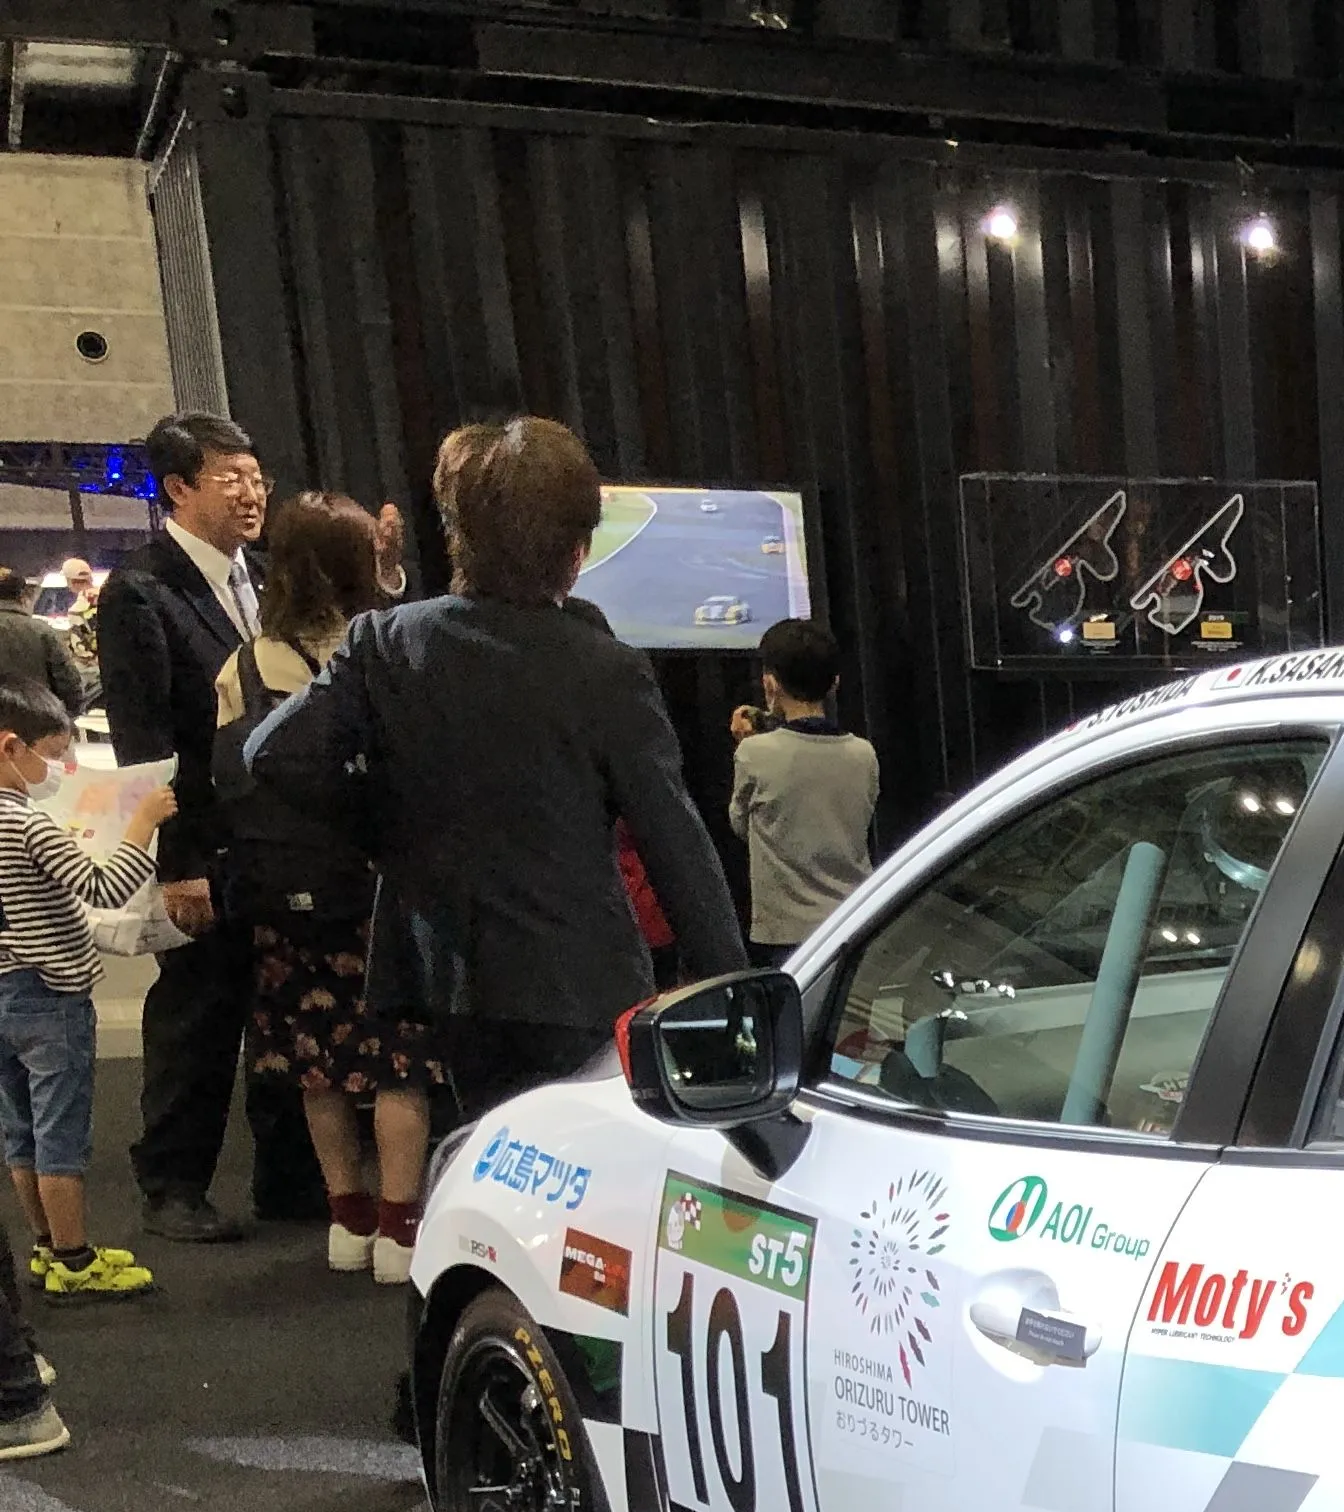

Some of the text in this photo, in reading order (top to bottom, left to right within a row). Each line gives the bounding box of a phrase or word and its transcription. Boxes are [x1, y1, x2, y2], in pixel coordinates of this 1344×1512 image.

[495, 1138, 592, 1211] 広島マツダ
[748, 1230, 807, 1287] ST5
[1040, 1202, 1150, 1260] AOI Group
[1147, 1261, 1314, 1339] Moty's
[834, 1348, 893, 1384] HIROSHIMA
[834, 1375, 950, 1436] ORIZURU TOWER
[836, 1410, 914, 1450] おりづるタワー
